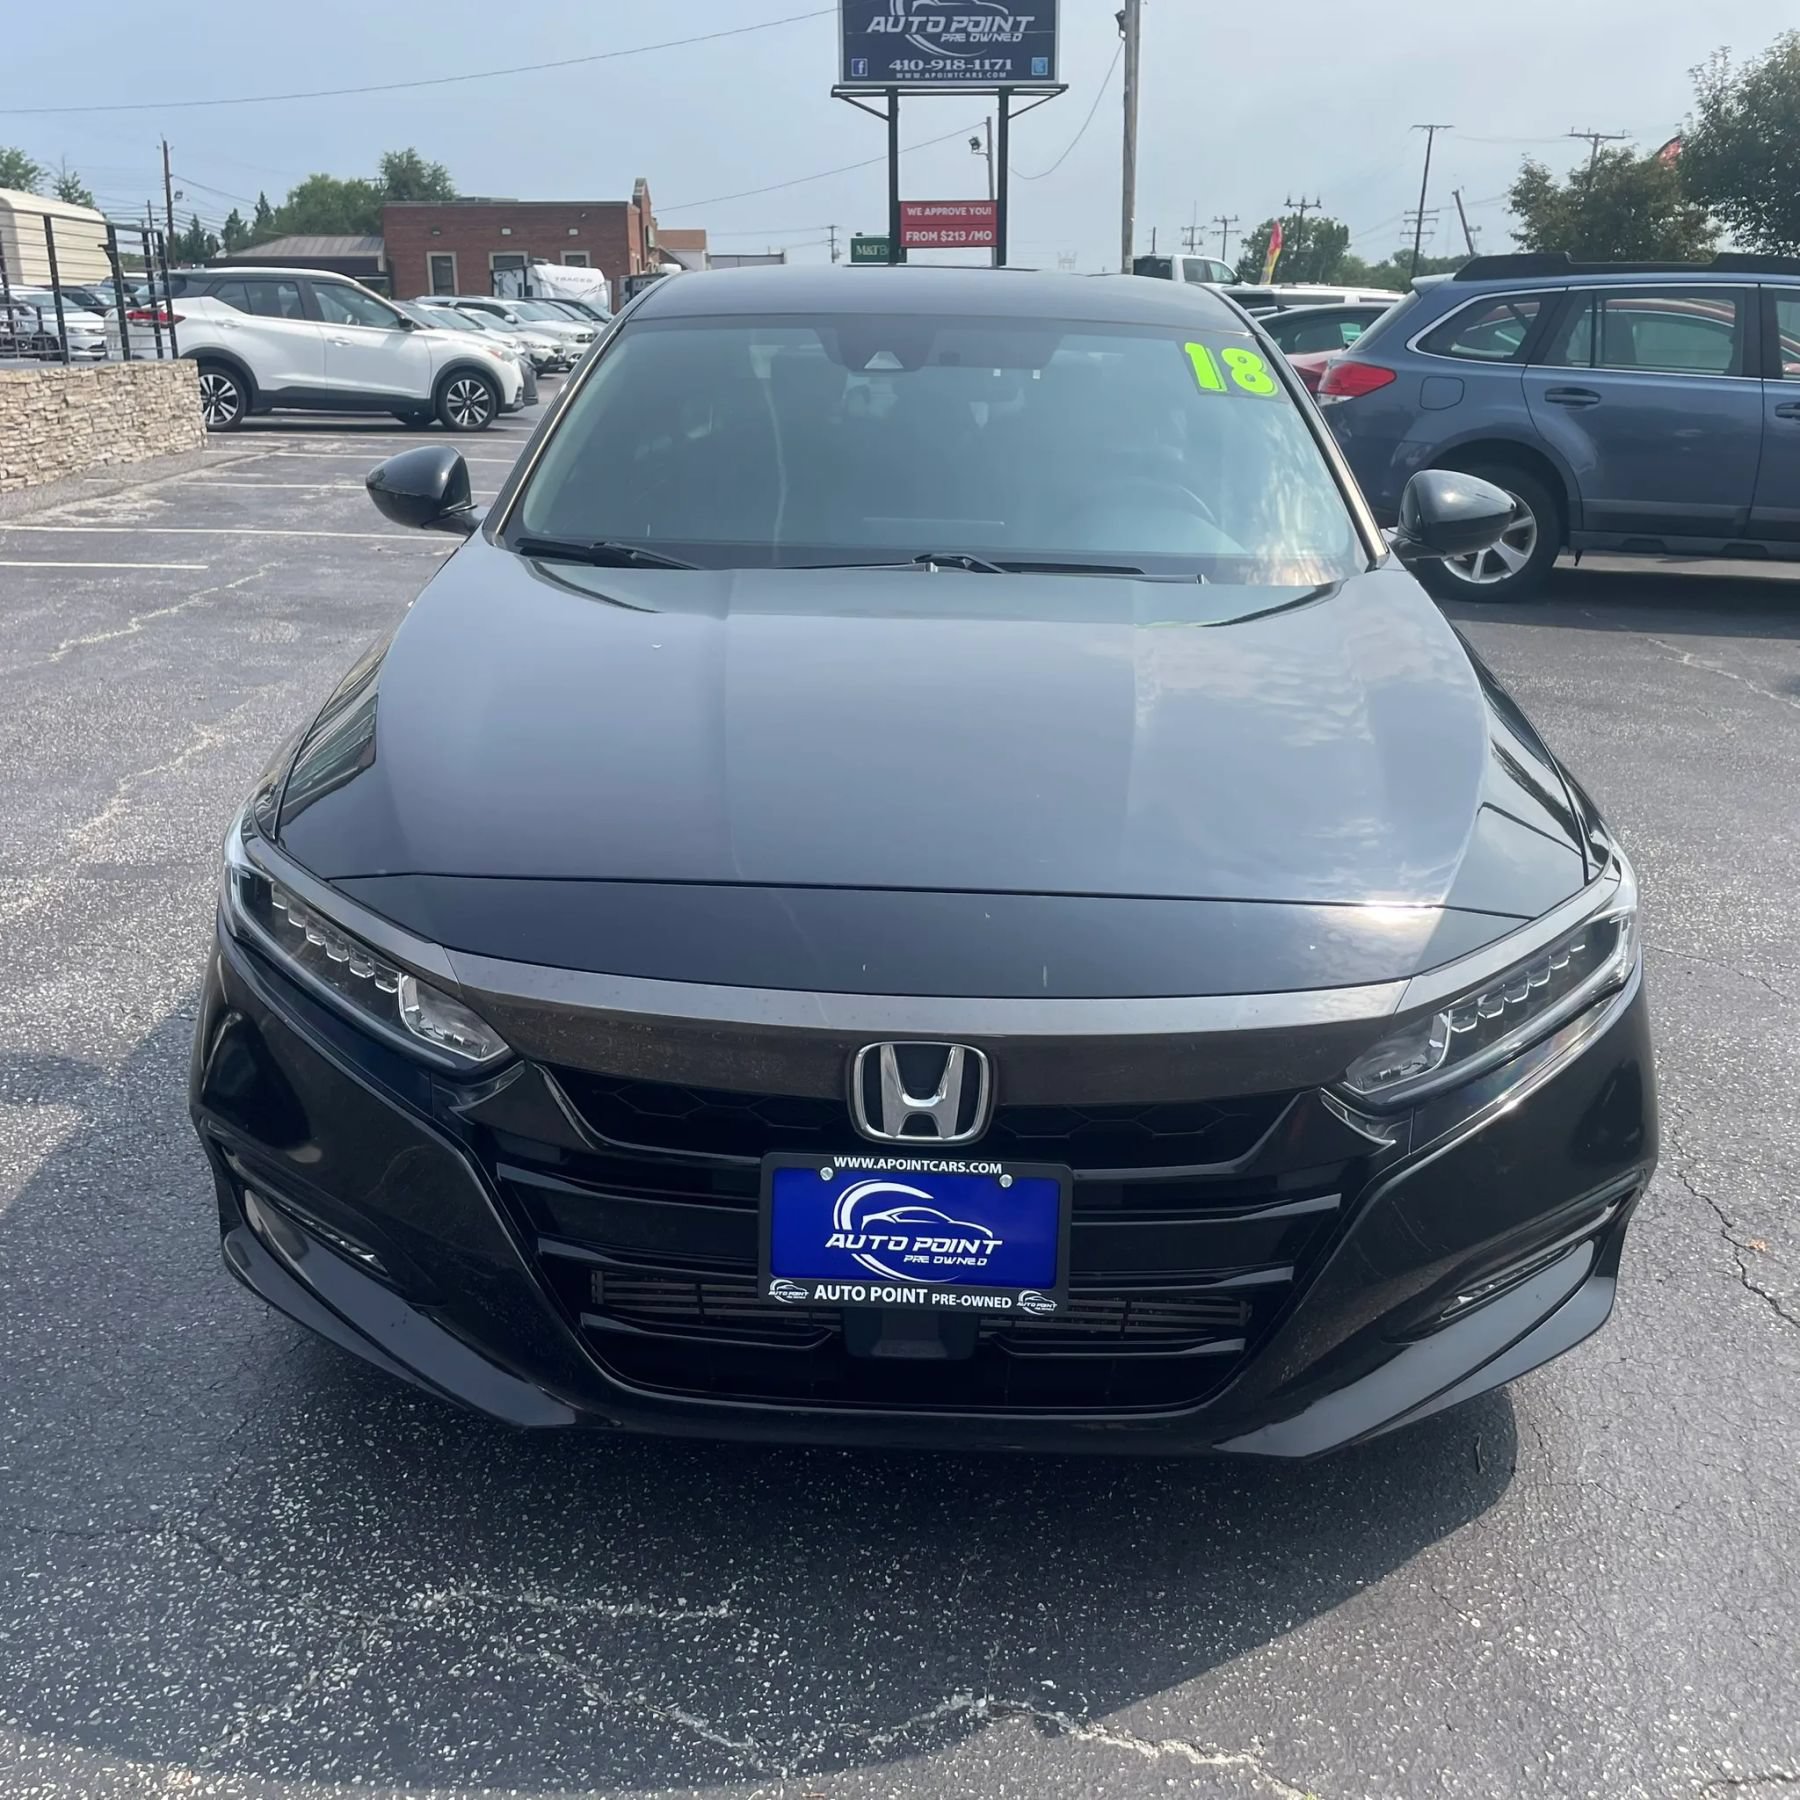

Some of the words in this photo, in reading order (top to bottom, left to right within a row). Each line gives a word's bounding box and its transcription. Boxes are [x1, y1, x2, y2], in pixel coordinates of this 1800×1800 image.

[866, 16, 946, 33] AUTO
[950, 16, 1035, 33] POINT
[940, 33, 966, 42] PRE
[969, 33, 1023, 42] OWNED
[889, 59, 1013, 71] 410-918-1171
[896, 71, 1007, 79] WWW.APOINTCARS.COM
[907, 207, 922, 216] WE
[924, 207, 967, 216] APPROVE
[969, 207, 992, 216] YOU!
[906, 231, 938, 242] FROM
[940, 230, 966, 242] $213
[968, 230, 992, 242] /MO
[1184, 342, 1279, 397] 18
[833, 1156, 1003, 1174] WWW.APOINTCARS.COM
[825, 1233, 909, 1251] AUTO
[912, 1237, 1003, 1255] POINT
[903, 1254, 930, 1264] PRE
[933, 1255, 988, 1266] OWNED
[813, 1284, 866, 1301] AUTO
[870, 1286, 928, 1304] POINT
[931, 1293, 1012, 1309] PRE-OWNED
